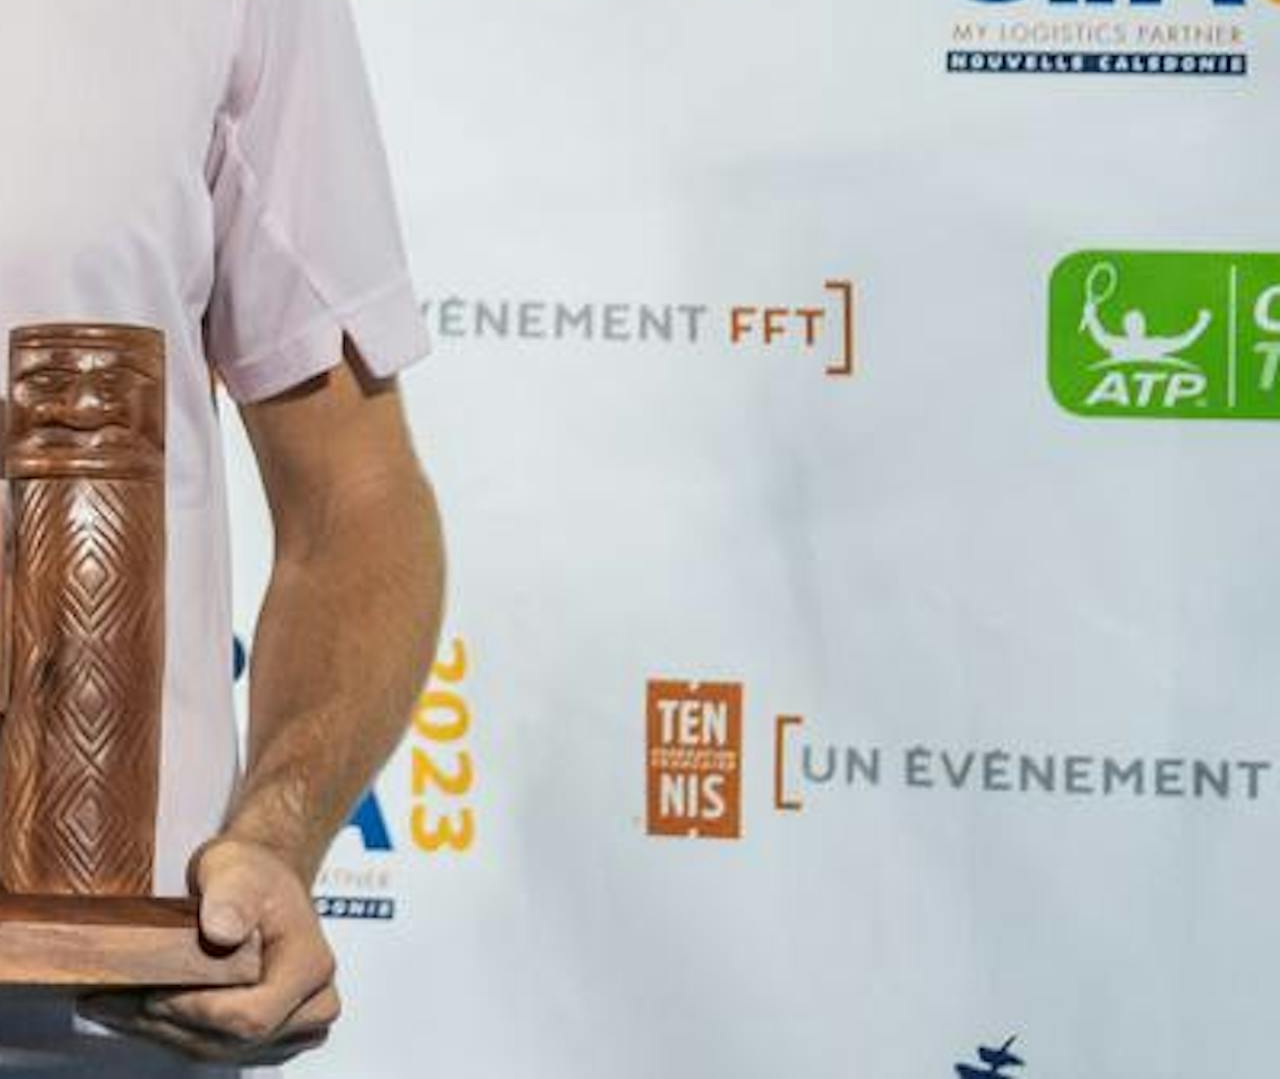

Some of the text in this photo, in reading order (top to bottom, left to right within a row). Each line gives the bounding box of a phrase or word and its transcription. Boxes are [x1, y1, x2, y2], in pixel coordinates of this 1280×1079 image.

[952, 22, 1245, 46] MY LOGISTICS PARTNER
[950, 52, 1084, 70] NOUVELLE
[421, 294, 826, 346] ÉNEMENT FFT
[1085, 370, 1208, 408] ATP
[657, 699, 728, 745] TEN
[659, 772, 725, 818] NIS
[801, 745, 1271, 799] UN ÉVÉNEMENT
